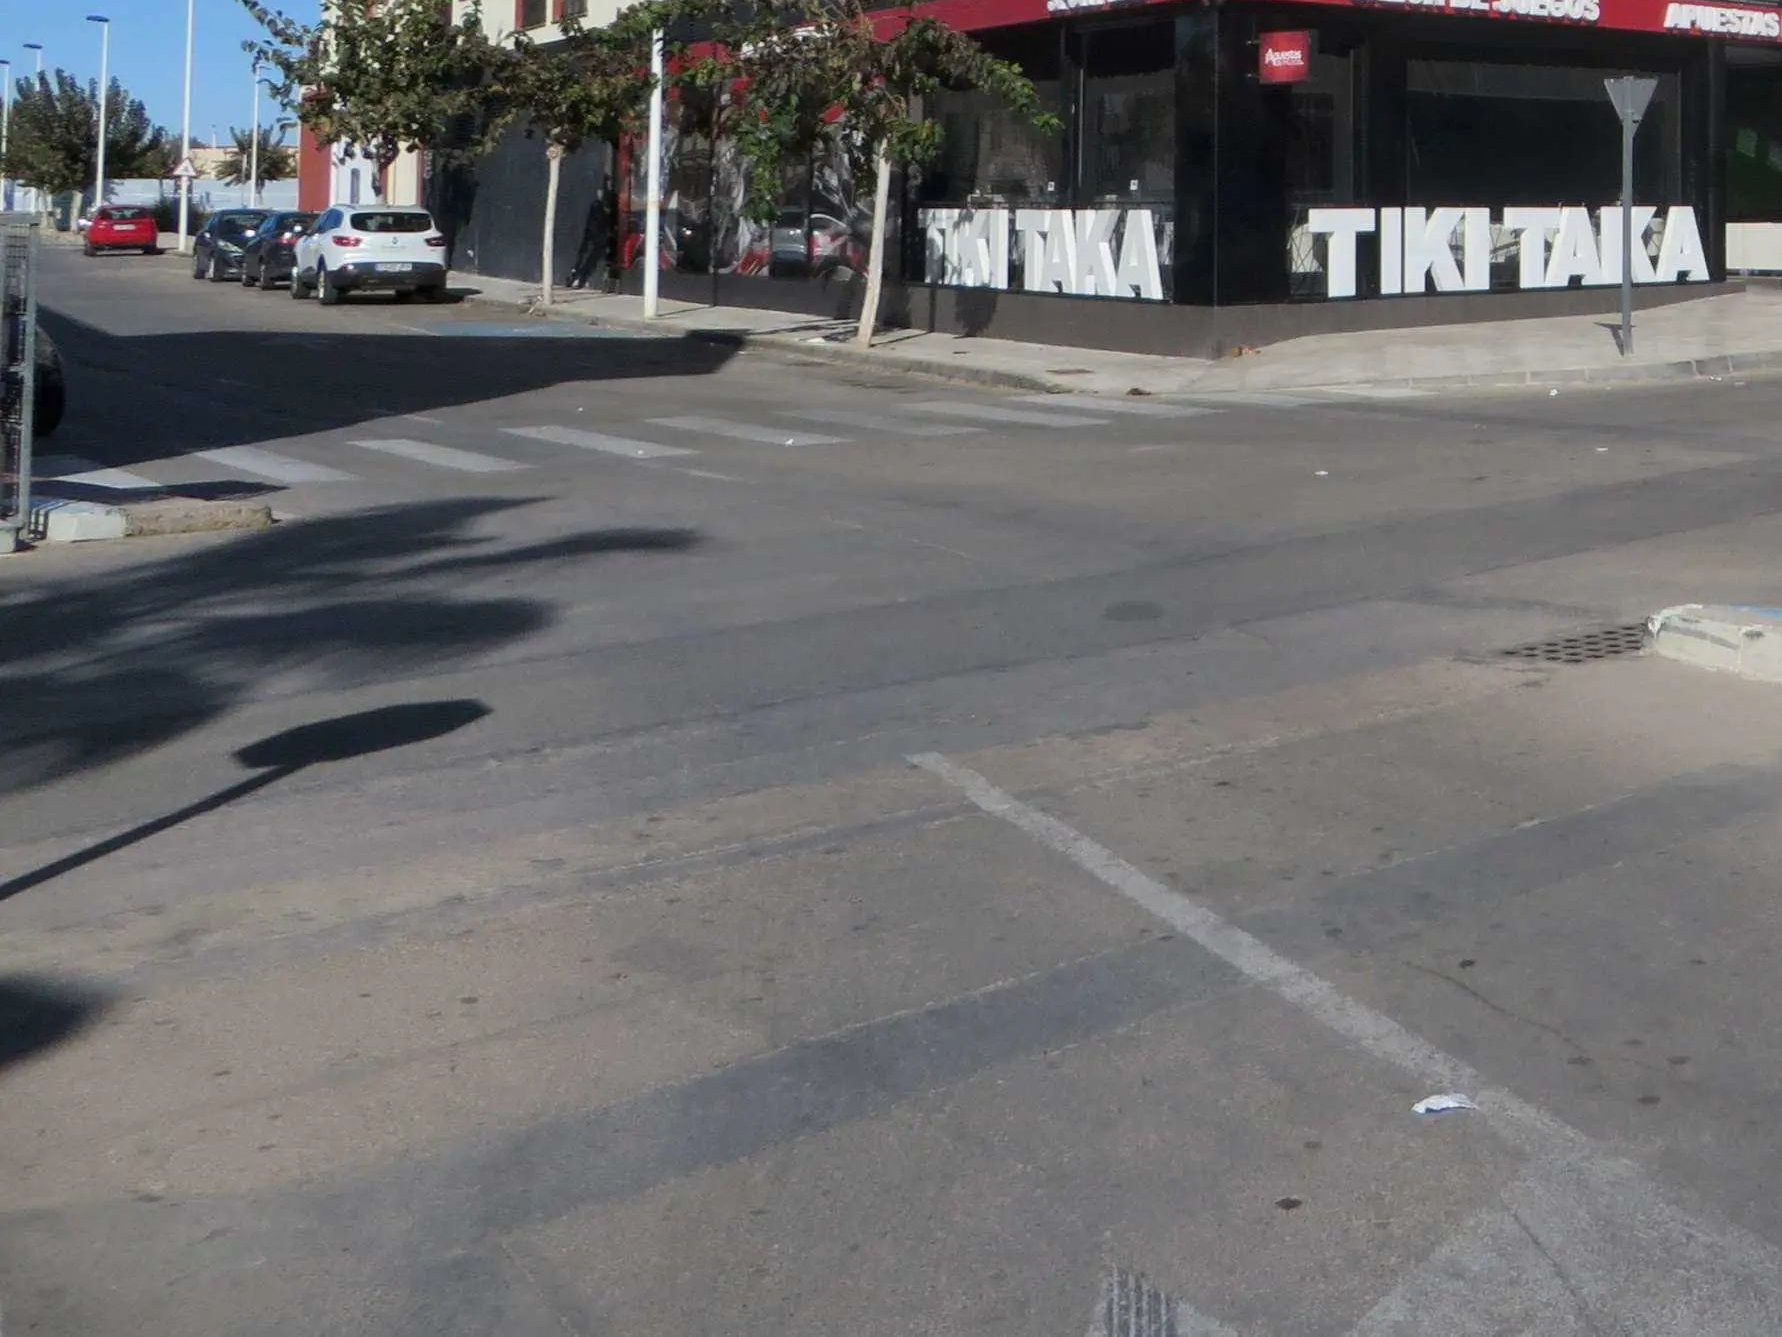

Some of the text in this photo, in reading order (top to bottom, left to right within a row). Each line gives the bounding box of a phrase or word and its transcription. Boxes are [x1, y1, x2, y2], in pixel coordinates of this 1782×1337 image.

[1663, 3, 1780, 38] APUESTAS
[918, 208, 1163, 300] TIKI TAKA
[1309, 206, 1710, 298] TIKI TAKA
